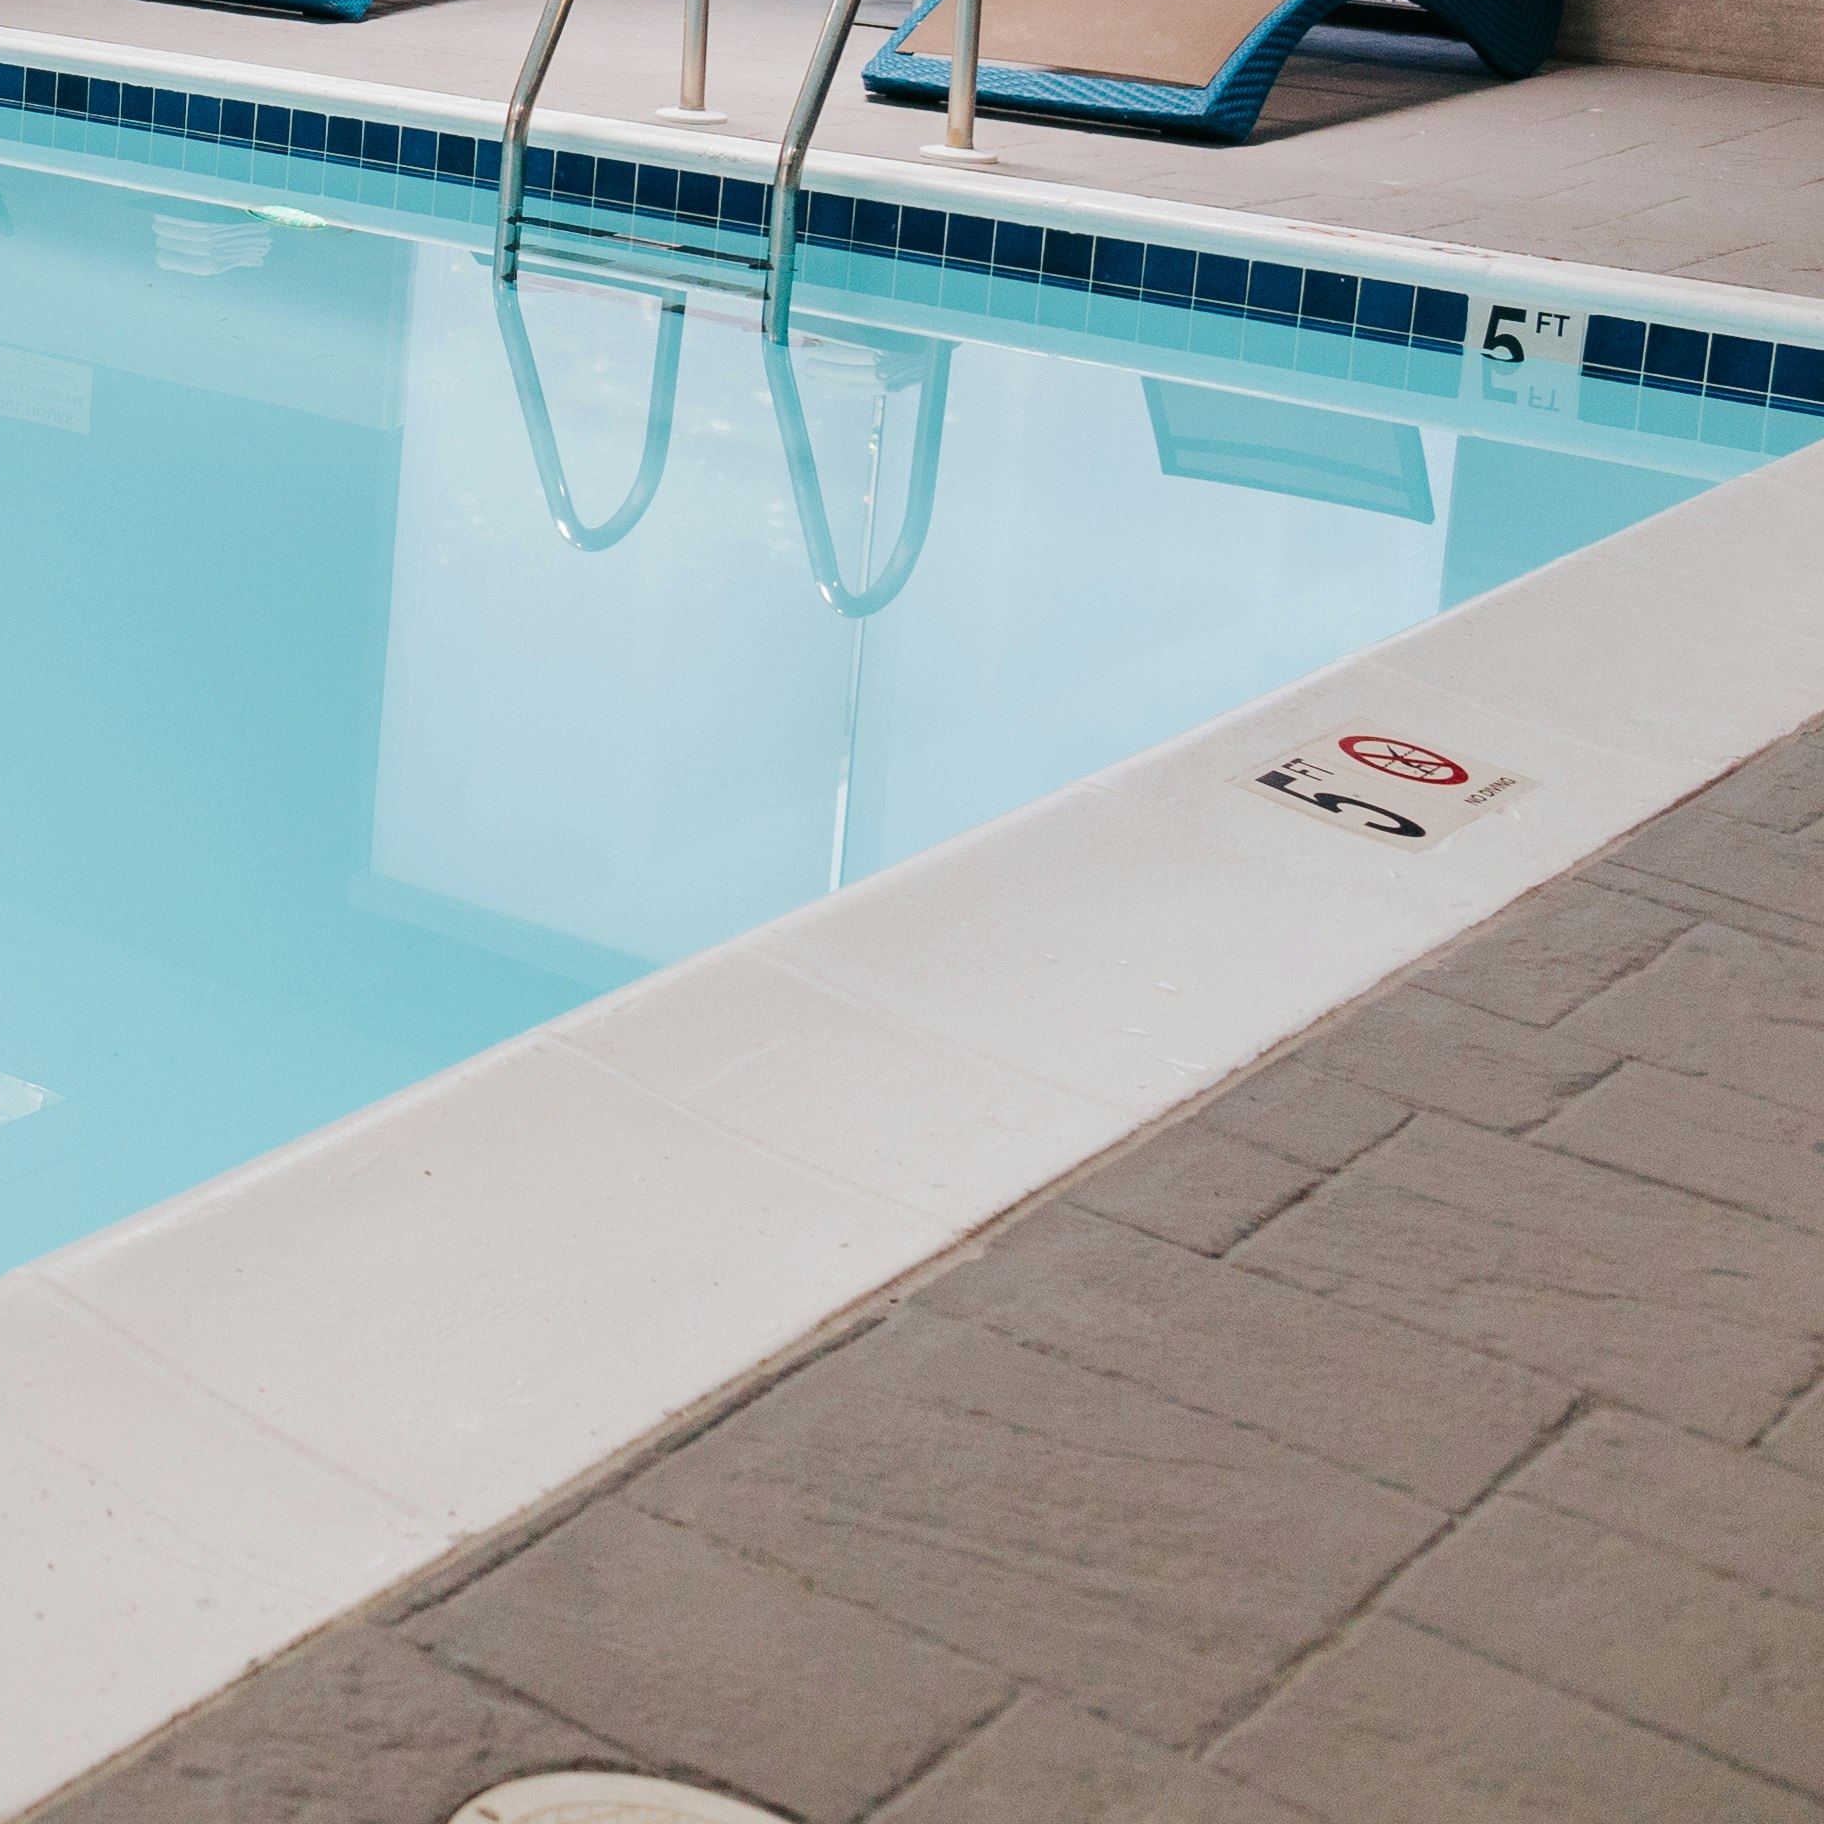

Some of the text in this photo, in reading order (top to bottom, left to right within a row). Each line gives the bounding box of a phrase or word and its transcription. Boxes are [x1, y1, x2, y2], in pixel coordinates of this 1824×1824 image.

[1481, 304, 1570, 363] 5 FT
[1255, 758, 1426, 838] 5 FT
[1464, 776, 1516, 806] NO DIVING
